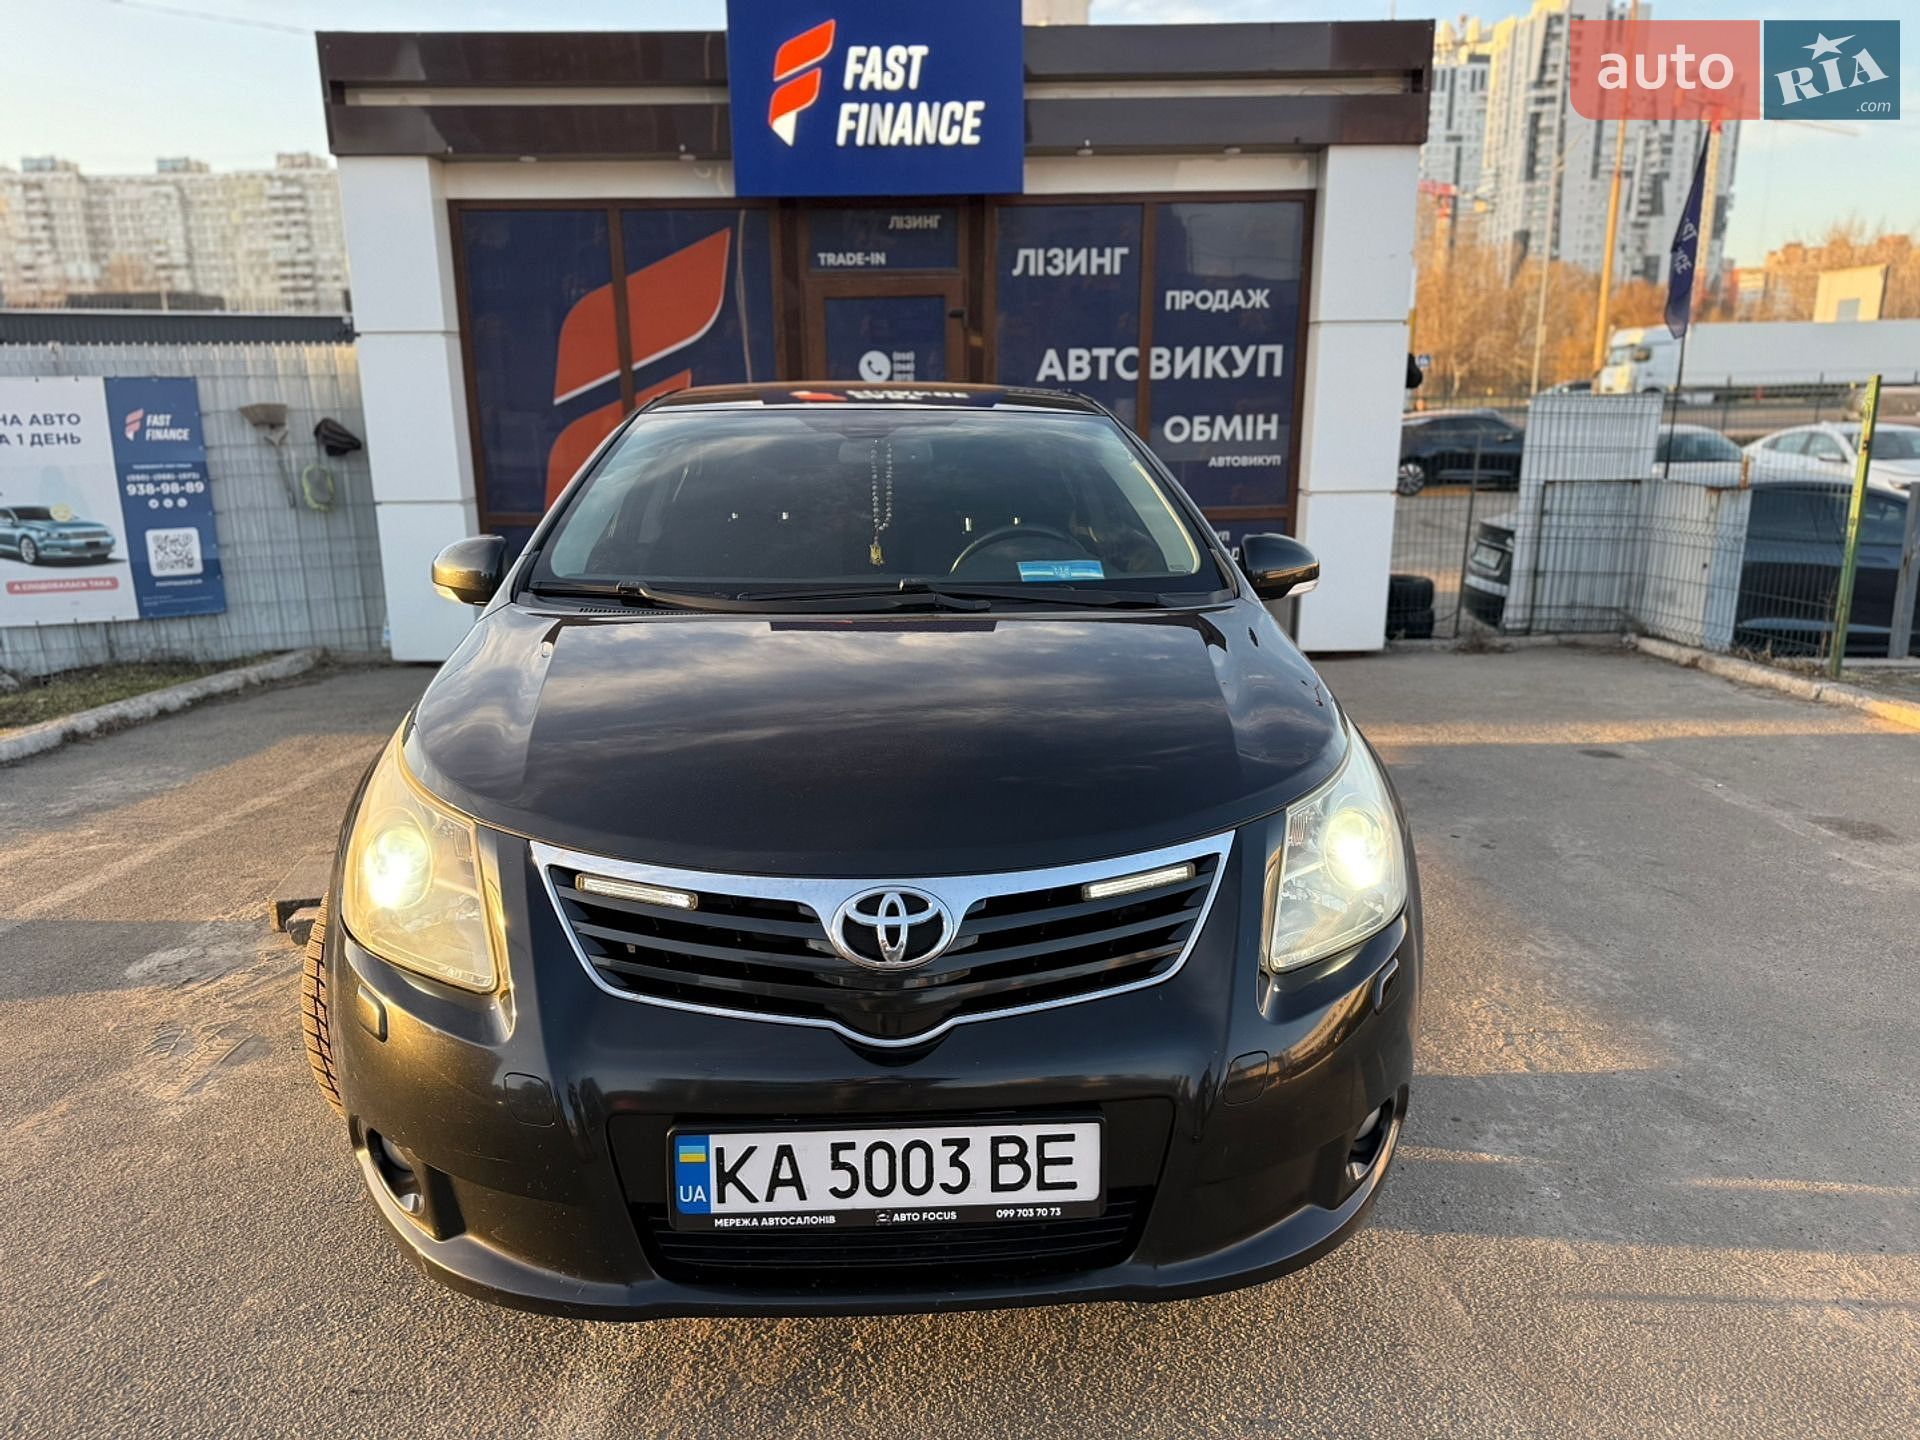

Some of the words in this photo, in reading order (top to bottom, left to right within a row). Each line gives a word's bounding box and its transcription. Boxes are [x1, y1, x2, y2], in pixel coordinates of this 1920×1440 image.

[843, 45, 929, 91] FAST
[836, 100, 986, 147] FINANCE
[889, 215, 941, 230] ЛІЗИНГ
[818, 253, 886, 266] TRADE-IN
[1012, 248, 1129, 277] ЛІЗИНГ
[1165, 289, 1270, 312] ПРОДАЖ
[29, 413, 81, 426] АВТО
[146, 414, 172, 427] FAST
[145, 428, 190, 441] FINANCE
[1163, 414, 1279, 442] ОБМІН
[16, 433, 24, 446] 1
[30, 432, 82, 448] ДЕНЬ
[1208, 455, 1282, 468] АВТОВИКУП
[714, 1143, 808, 1204] KA
[828, 1137, 972, 1200] 5003
[989, 1133, 1078, 1193] BE
[679, 1185, 707, 1203] UA
[892, 1212, 920, 1222] АВТО
[922, 1211, 957, 1221] FOCUS
[996, 1209, 1014, 1218] 099
[1016, 1208, 1034, 1217] 703
[1036, 1208, 1048, 1217] 70
[1049, 1207, 1062, 1216] 73
[714, 1217, 759, 1227] МЕРЕЖА
[760, 1215, 836, 1226] АВТОСАЛОНІВ
